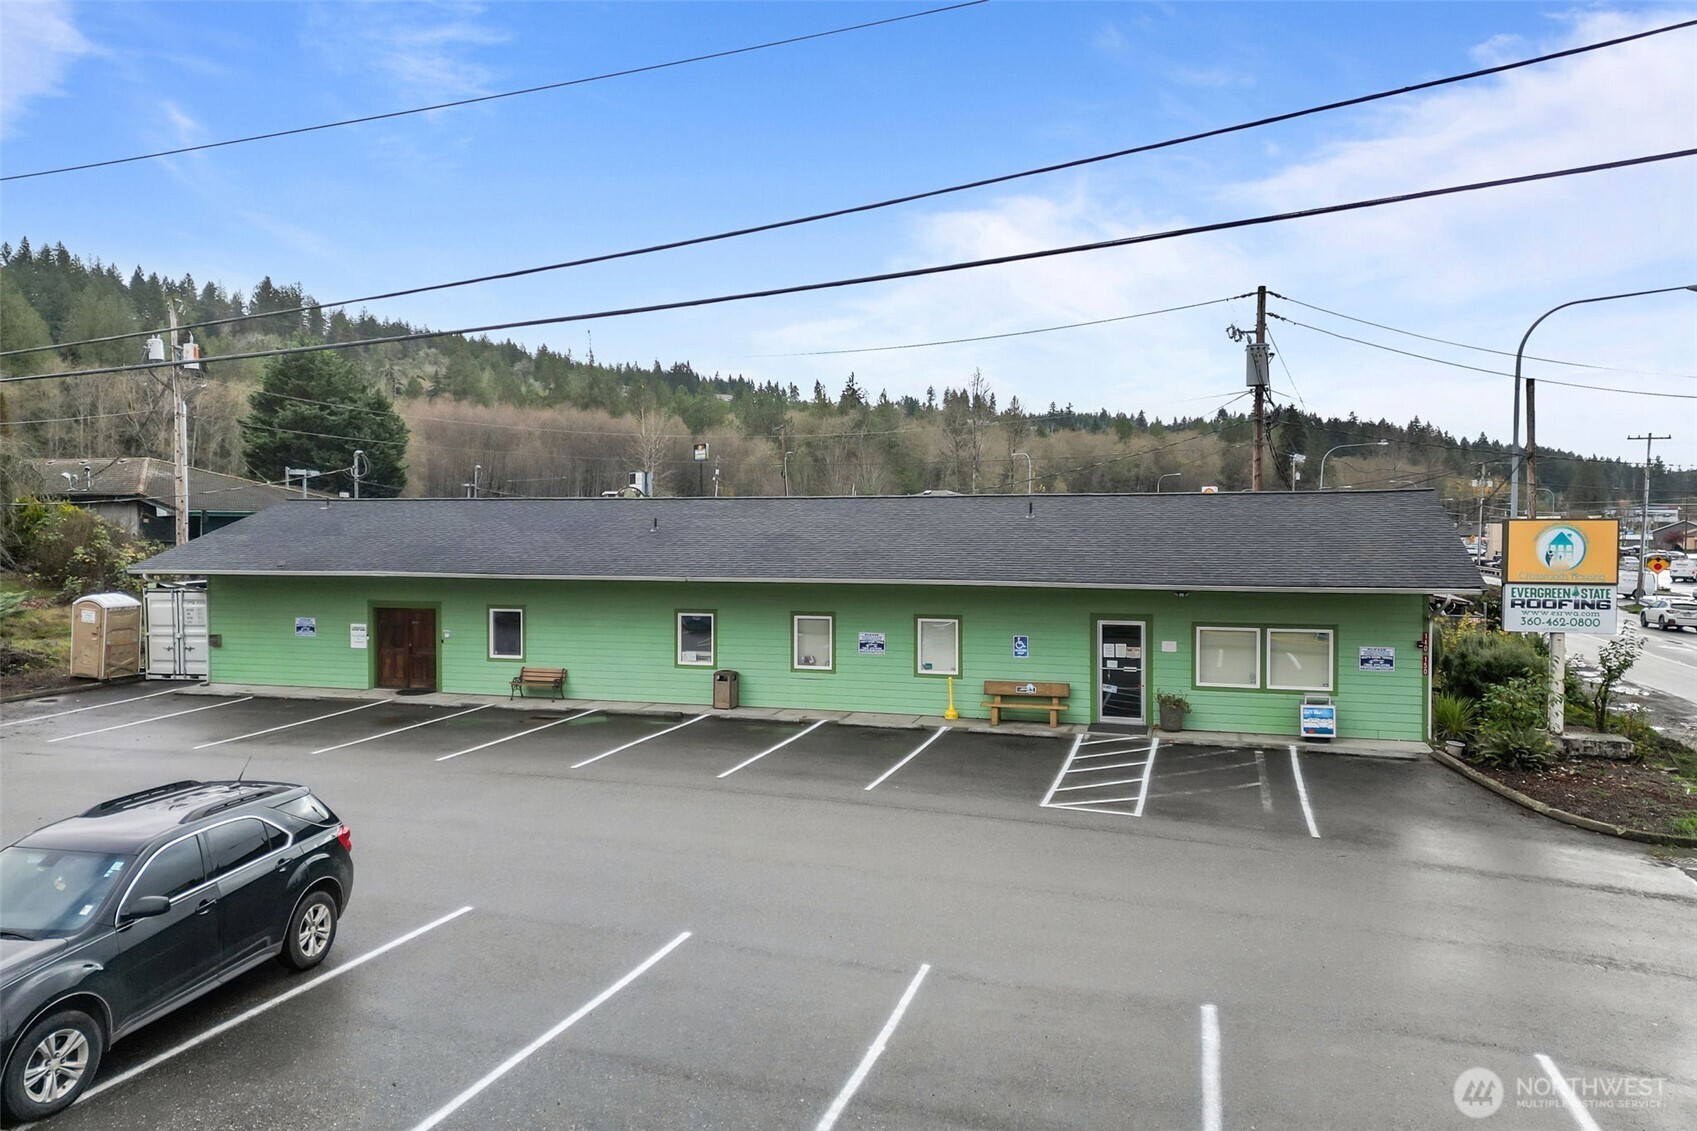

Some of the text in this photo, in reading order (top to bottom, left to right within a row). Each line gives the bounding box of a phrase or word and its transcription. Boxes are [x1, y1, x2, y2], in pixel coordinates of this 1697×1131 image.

[1511, 587, 1612, 599] EVERGREEN STATE
[1510, 599, 1612, 610] ROOFING
[1521, 609, 1600, 617] www.esrwa.com
[1520, 616, 1601, 627] 360-462-0800
